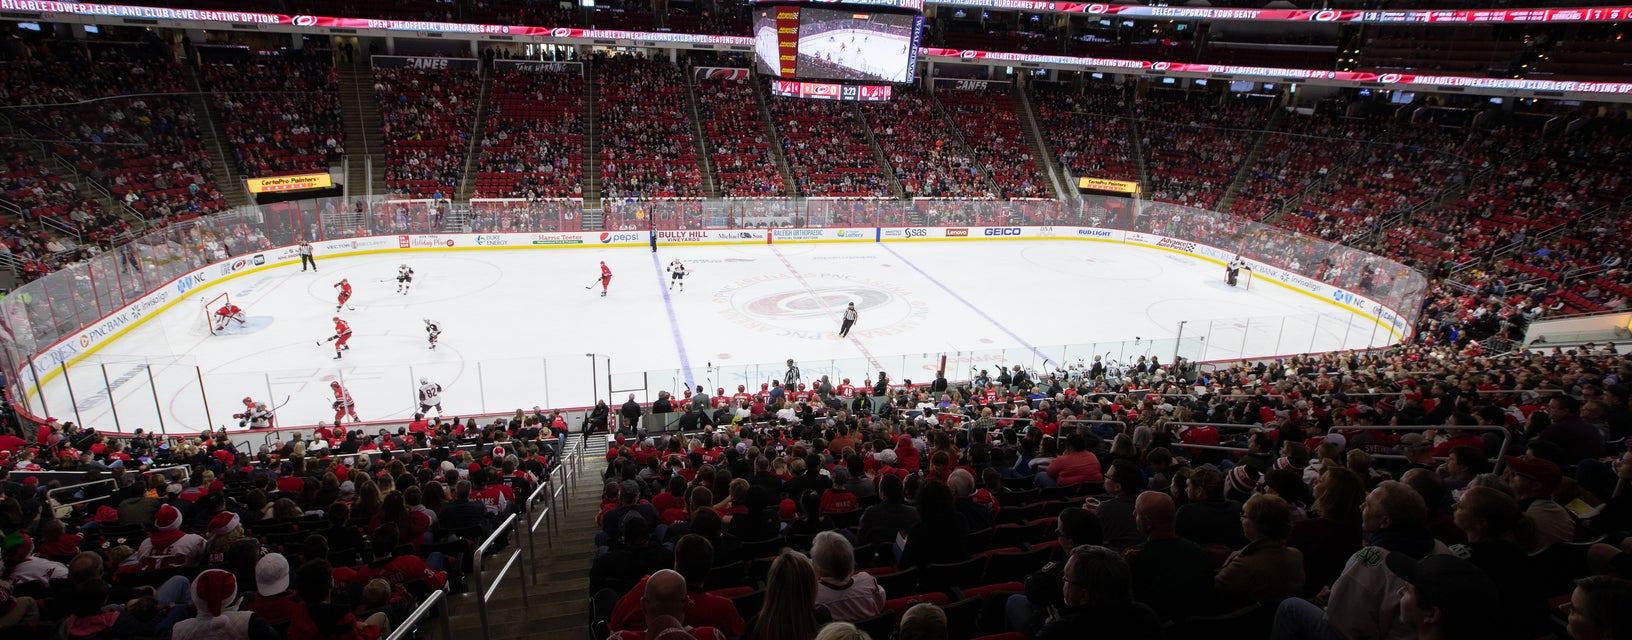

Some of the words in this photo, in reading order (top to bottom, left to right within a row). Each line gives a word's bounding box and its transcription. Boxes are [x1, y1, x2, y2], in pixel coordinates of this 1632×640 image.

[994, 1, 1034, 9] HURRICANES
[1035, 2, 1046, 10] APP
[51, 3, 87, 13] LOWER
[90, 5, 120, 15] LEVEL
[122, 7, 142, 16] AND
[145, 8, 170, 17] CLUB
[172, 10, 199, 19] LEVEL
[200, 11, 239, 21] SEATING
[241, 13, 280, 23] OPTIONS
[1152, 8, 1176, 16] SELECT
[1213, 10, 1233, 18] YOUR
[367, 20, 388, 28] OPEN
[389, 21, 403, 29] THE
[405, 21, 439, 31] OFFICIAL
[439, 23, 485, 32] HURRICANES
[486, 25, 500, 33] APP
[582, 30, 617, 39] AVAILABLE
[617, 31, 639, 40] LOWER
[640, 33, 658, 41] LEVEL
[673, 34, 688, 42] CLUB
[690, 35, 708, 43] LEVEL
[708, 36, 733, 44] SEATING
[406, 58, 449, 70] CANES
[985, 52, 1013, 60] AVAILABLE
[1013, 53, 1032, 61] LOWER
[1047, 55, 1059, 63] AND
[1061, 56, 1075, 64] CLUB
[1077, 57, 1092, 65] LEVEL
[1093, 58, 1117, 67] SEATING
[1118, 60, 1143, 68] OPTIONS
[535, 63, 567, 73] WARNING
[1208, 65, 1224, 73] OPEN
[1239, 67, 1267, 75] OFFICIAL
[1269, 68, 1310, 77] HURRICANES
[1311, 70, 1325, 78] APP
[1414, 76, 1453, 86] AVAILABLE
[1454, 78, 1482, 87] LOWER
[1483, 79, 1507, 88] LEVEL
[1509, 80, 1525, 88] AND
[1527, 81, 1550, 90] CLUB
[1551, 82, 1576, 91] LEVEL
[1578, 83, 1617, 93] SEATING
[843, 86, 856, 96] 3:23
[613, 233, 639, 242] pepsi
[984, 228, 1021, 236] GEICO
[1161, 237, 1187, 247] Advance
[194, 272, 206, 283] NC
[1291, 276, 1322, 291] invisalign
[1353, 298, 1366, 308] NC
[51, 340, 78, 365] REX
[425, 387, 437, 398] 82
[209, 553, 224, 562] AHO
